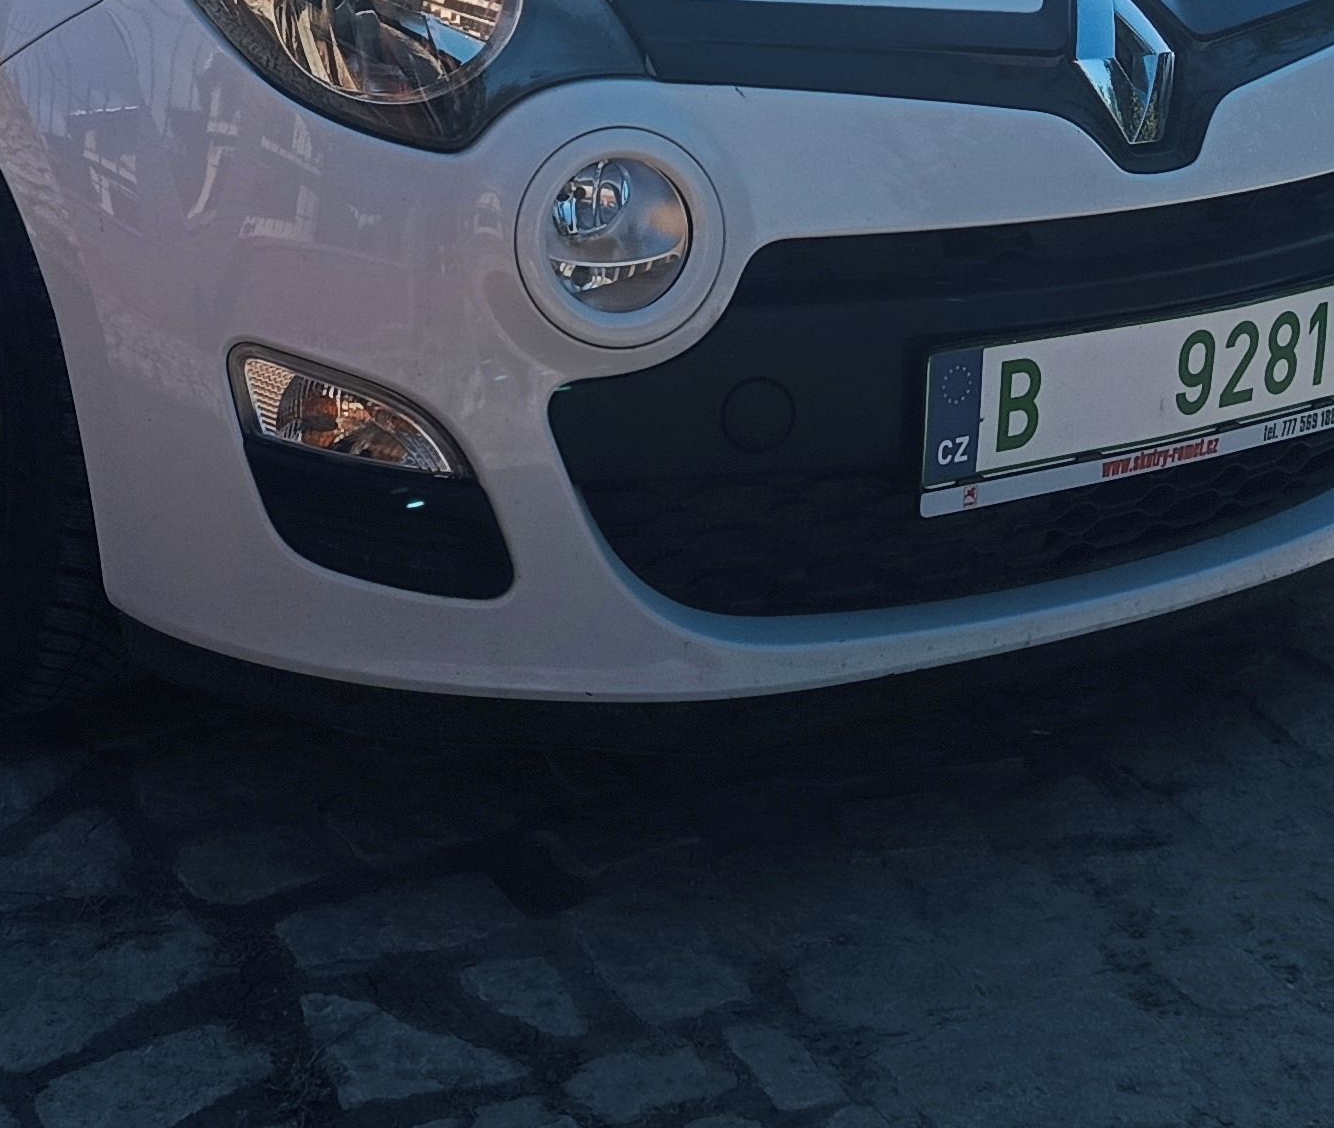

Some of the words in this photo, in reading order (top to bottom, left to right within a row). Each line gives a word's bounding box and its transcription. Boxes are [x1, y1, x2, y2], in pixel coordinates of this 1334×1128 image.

[996, 358, 1042, 452] B
[1175, 302, 1329, 415] 9281
[1281, 418, 1297, 437] 777
[938, 436, 970, 465] CZ
